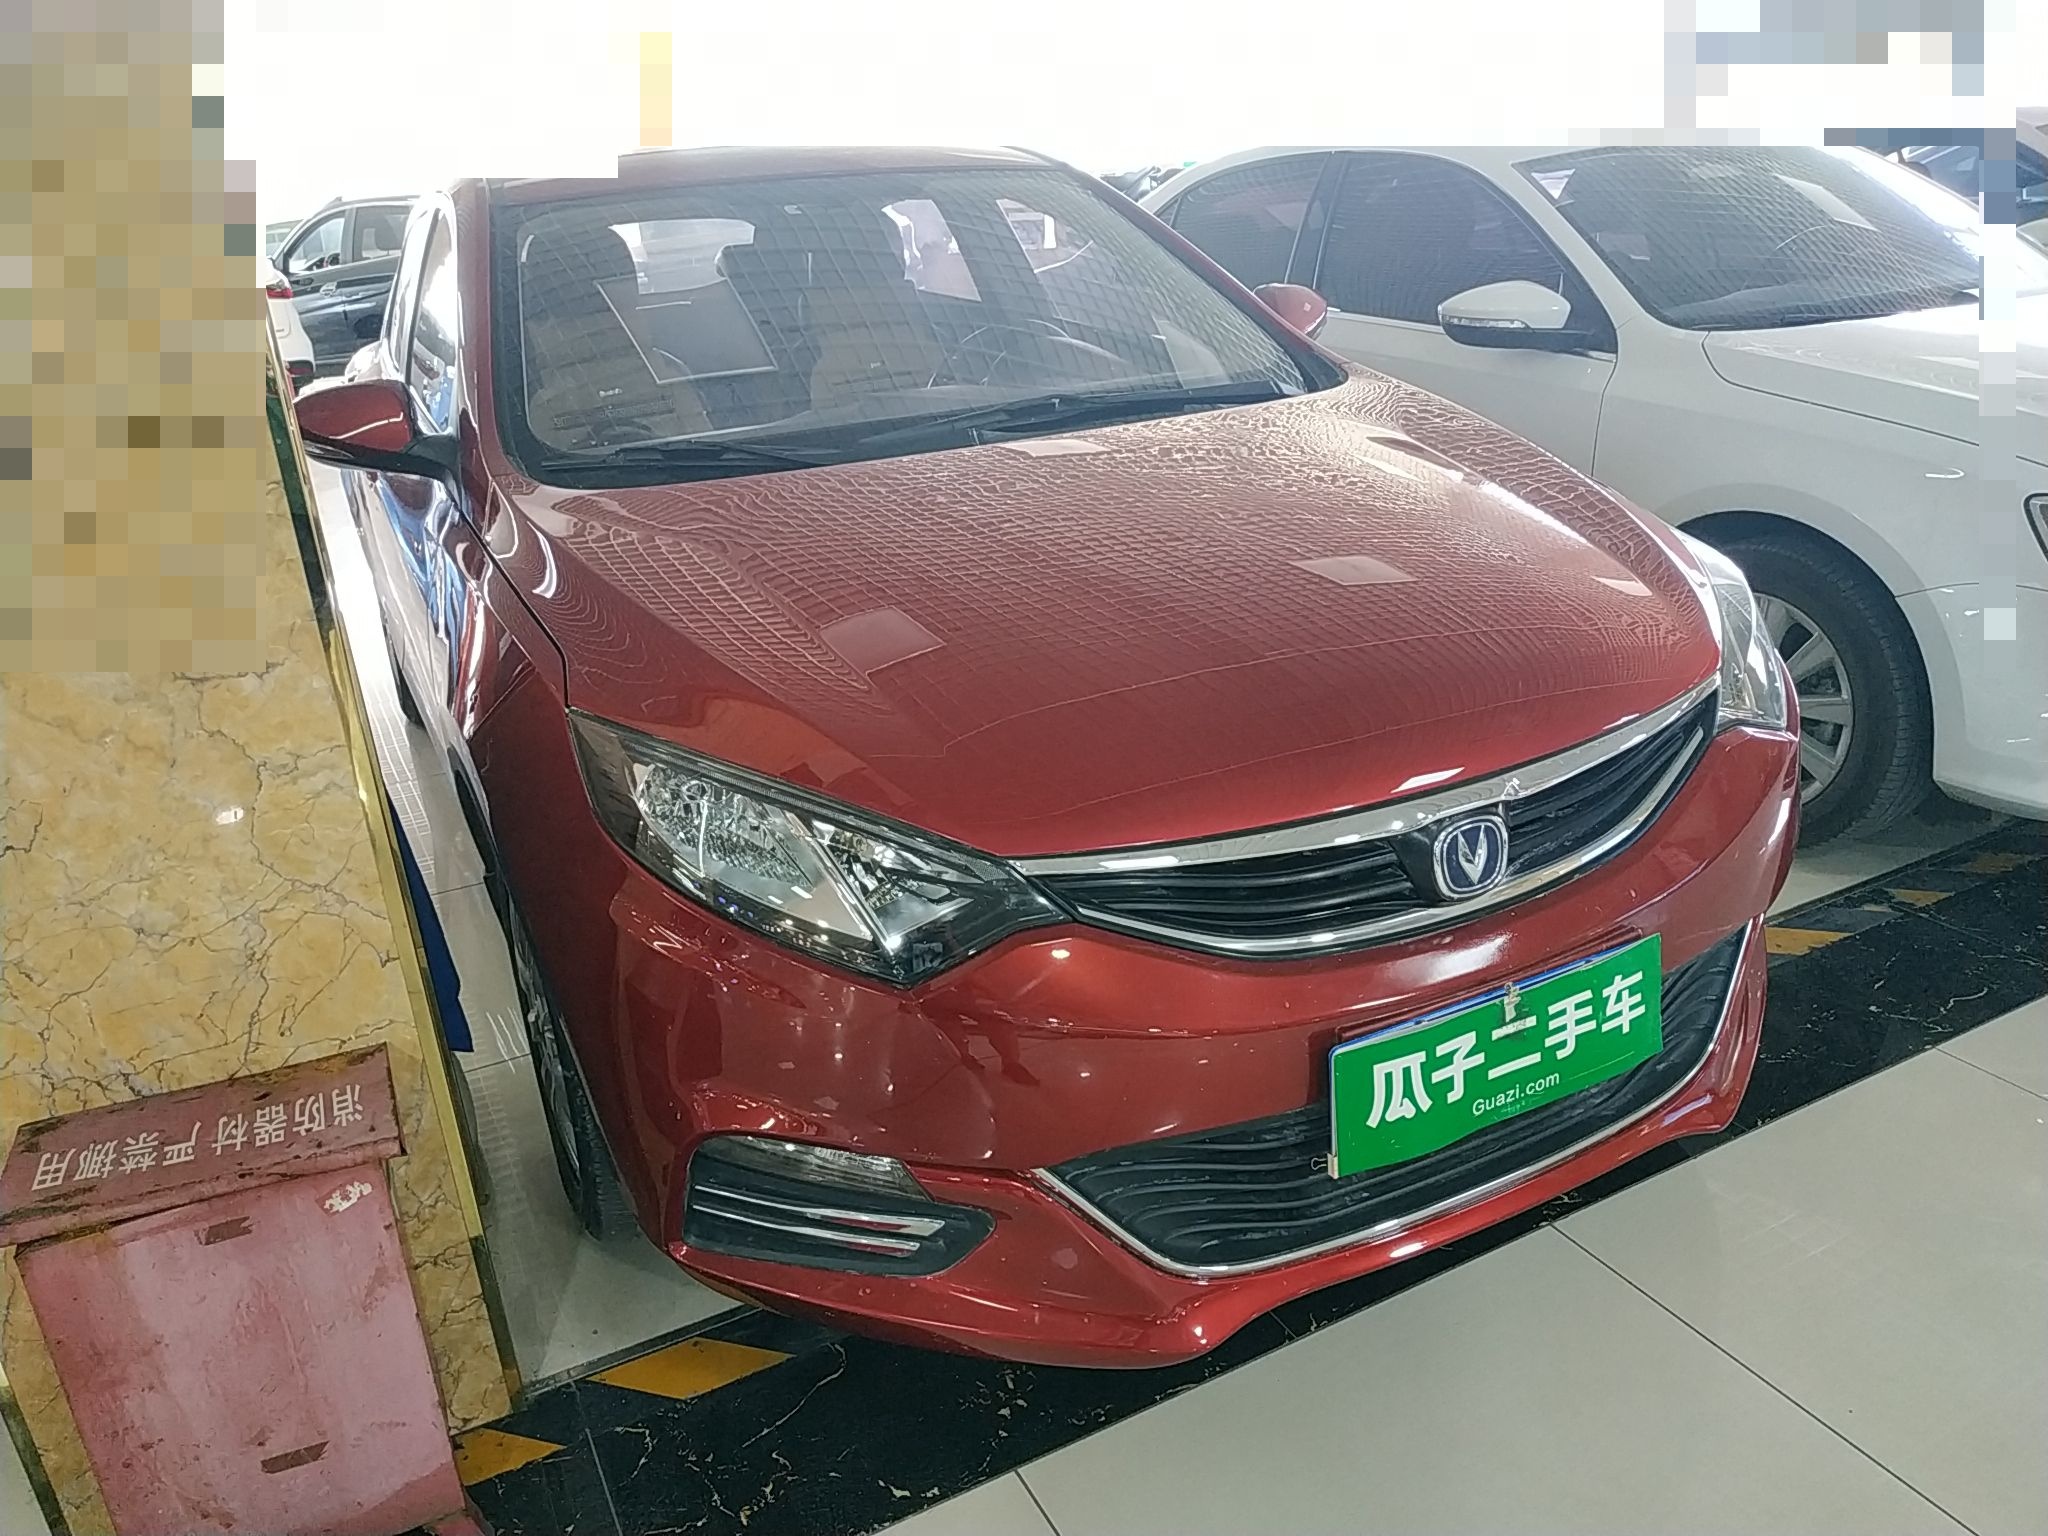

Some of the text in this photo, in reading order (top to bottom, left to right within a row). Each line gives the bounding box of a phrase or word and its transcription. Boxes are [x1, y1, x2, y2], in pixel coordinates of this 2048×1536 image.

[1367, 972, 1645, 1128] 瓜子二手车
[1472, 1073, 1560, 1116] Guazi.com
[31, 1084, 364, 1191] 消防器材 严禁挪用
